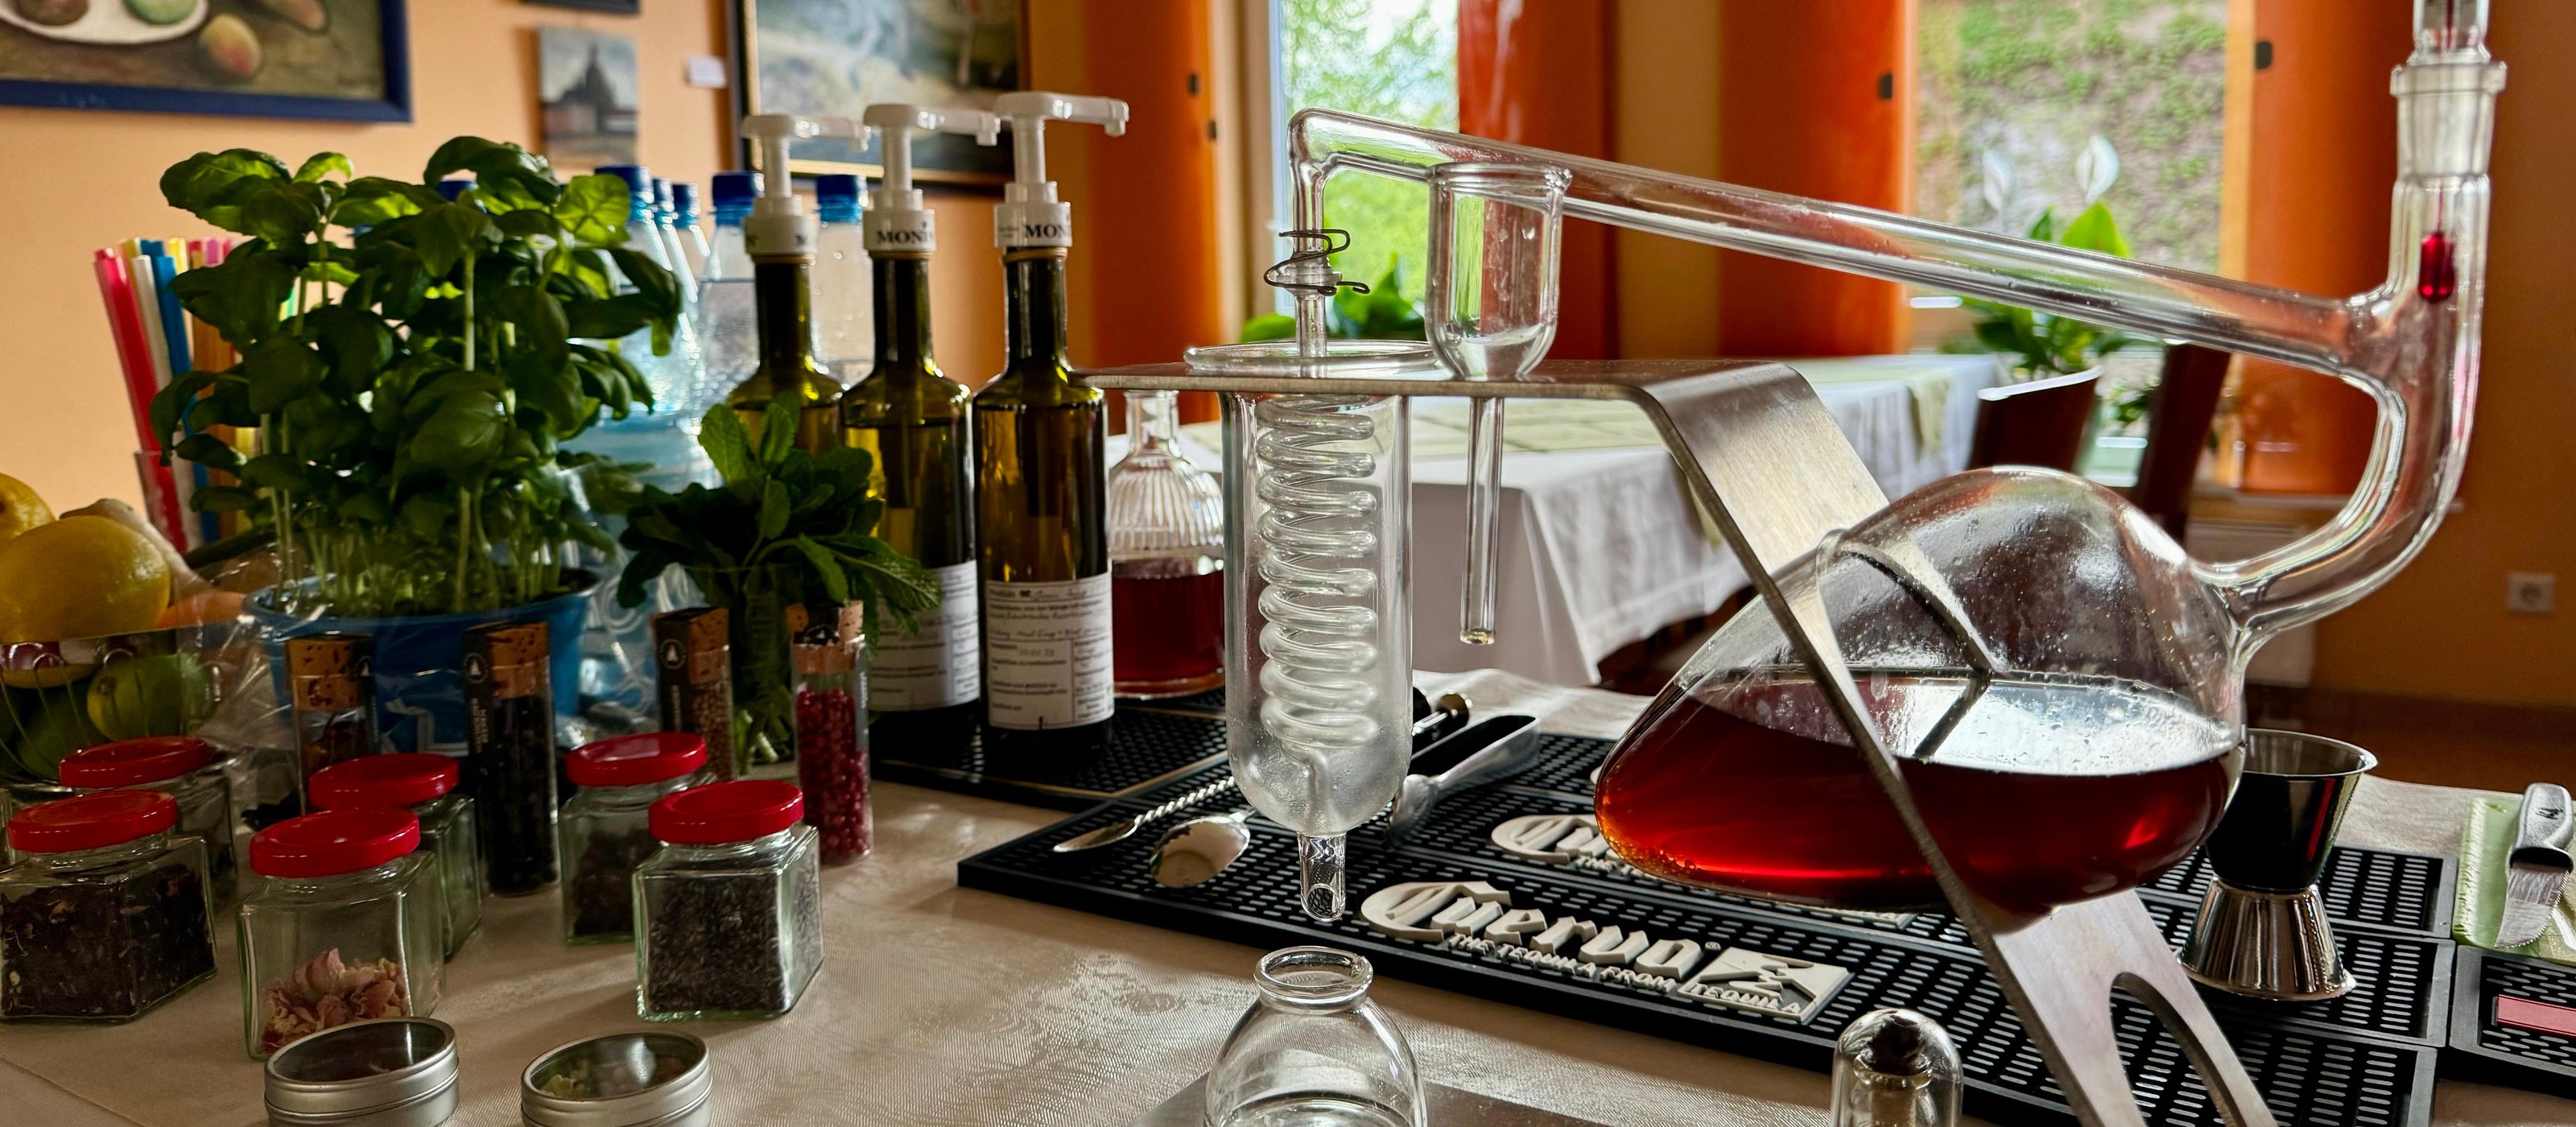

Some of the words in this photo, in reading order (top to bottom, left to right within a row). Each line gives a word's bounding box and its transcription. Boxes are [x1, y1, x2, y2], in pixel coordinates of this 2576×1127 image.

[876, 229, 931, 243] MONI
[1023, 224, 1067, 238] MON
[1361, 881, 1703, 979] Cuervo
[1448, 933, 1497, 956] THE
[1496, 943, 1598, 979] TEQUILA
[1600, 965, 1677, 993] FROM
[1689, 982, 1802, 1014] TEQUILA
